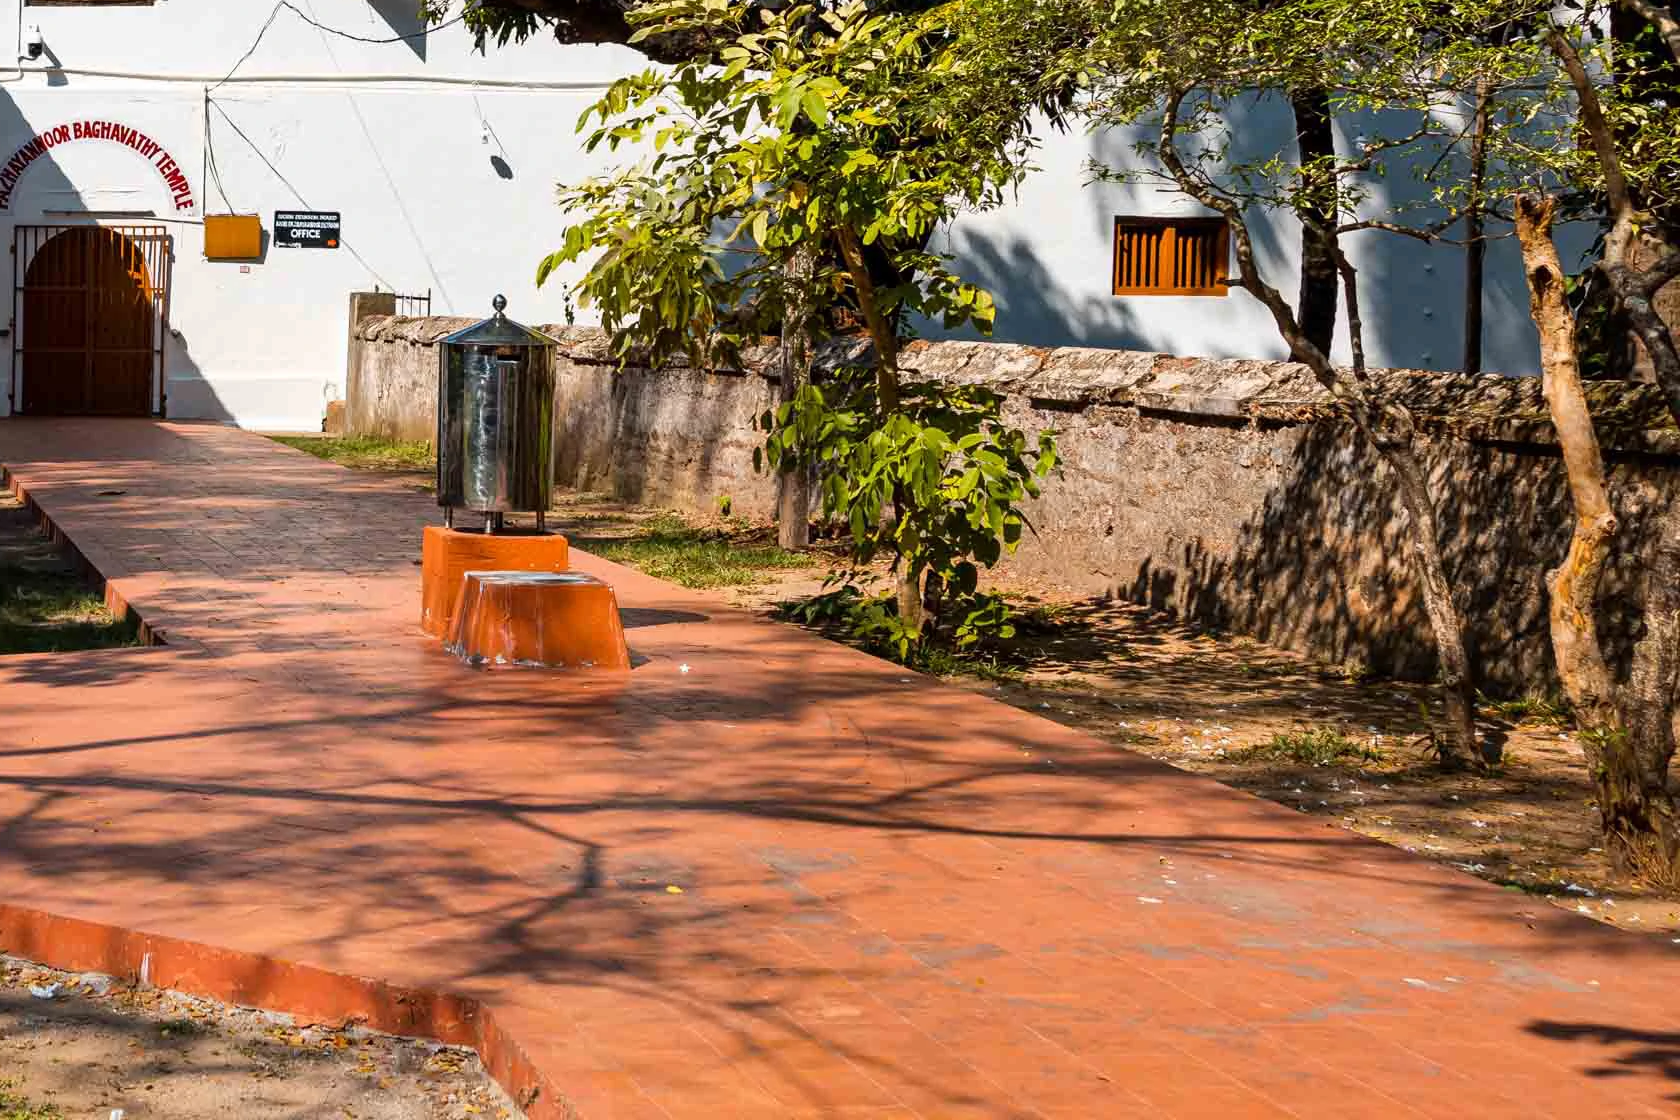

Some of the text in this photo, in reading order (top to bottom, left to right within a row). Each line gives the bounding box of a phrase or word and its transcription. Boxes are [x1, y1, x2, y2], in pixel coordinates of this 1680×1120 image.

[72, 121, 161, 160] BAGHAVATHY
[154, 152, 194, 211] TEMPLE
[290, 229, 321, 238] OFFICE
